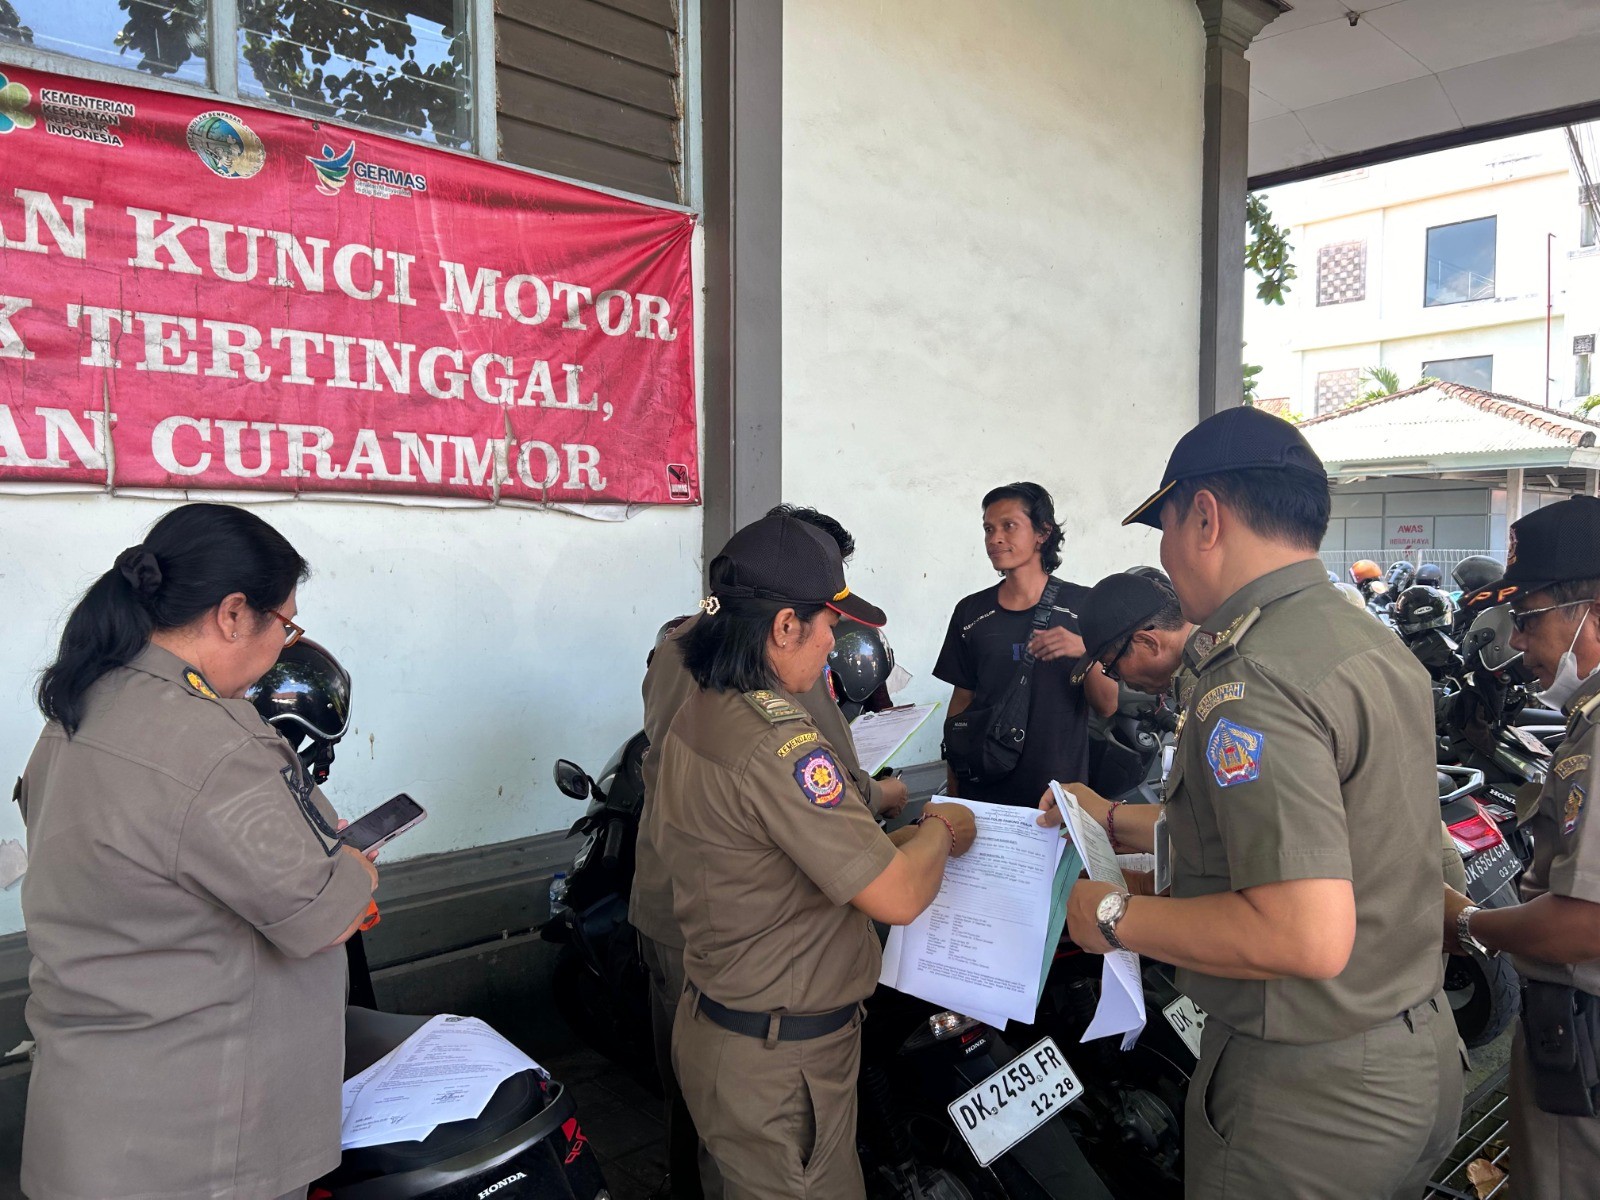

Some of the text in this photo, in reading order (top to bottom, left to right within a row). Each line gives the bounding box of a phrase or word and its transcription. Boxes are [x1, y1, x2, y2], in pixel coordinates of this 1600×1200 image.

[41, 89, 134, 116] KEMENTERIAN
[42, 103, 119, 125] KESEHATAN
[47, 123, 123, 146] INDONESIA
[354, 162, 426, 190] GERMAS
[0, 188, 678, 342] N KUNCI MOTOR
[67, 303, 614, 422] TERTINGGAL,
[151, 415, 607, 491] CURANMOR
[1397, 524, 1424, 534] AWAS
[1171, 1006, 1193, 1032] DK
[960, 1046, 1062, 1130] DK 2459 FR
[477, 1172, 527, 1200] HONDA
